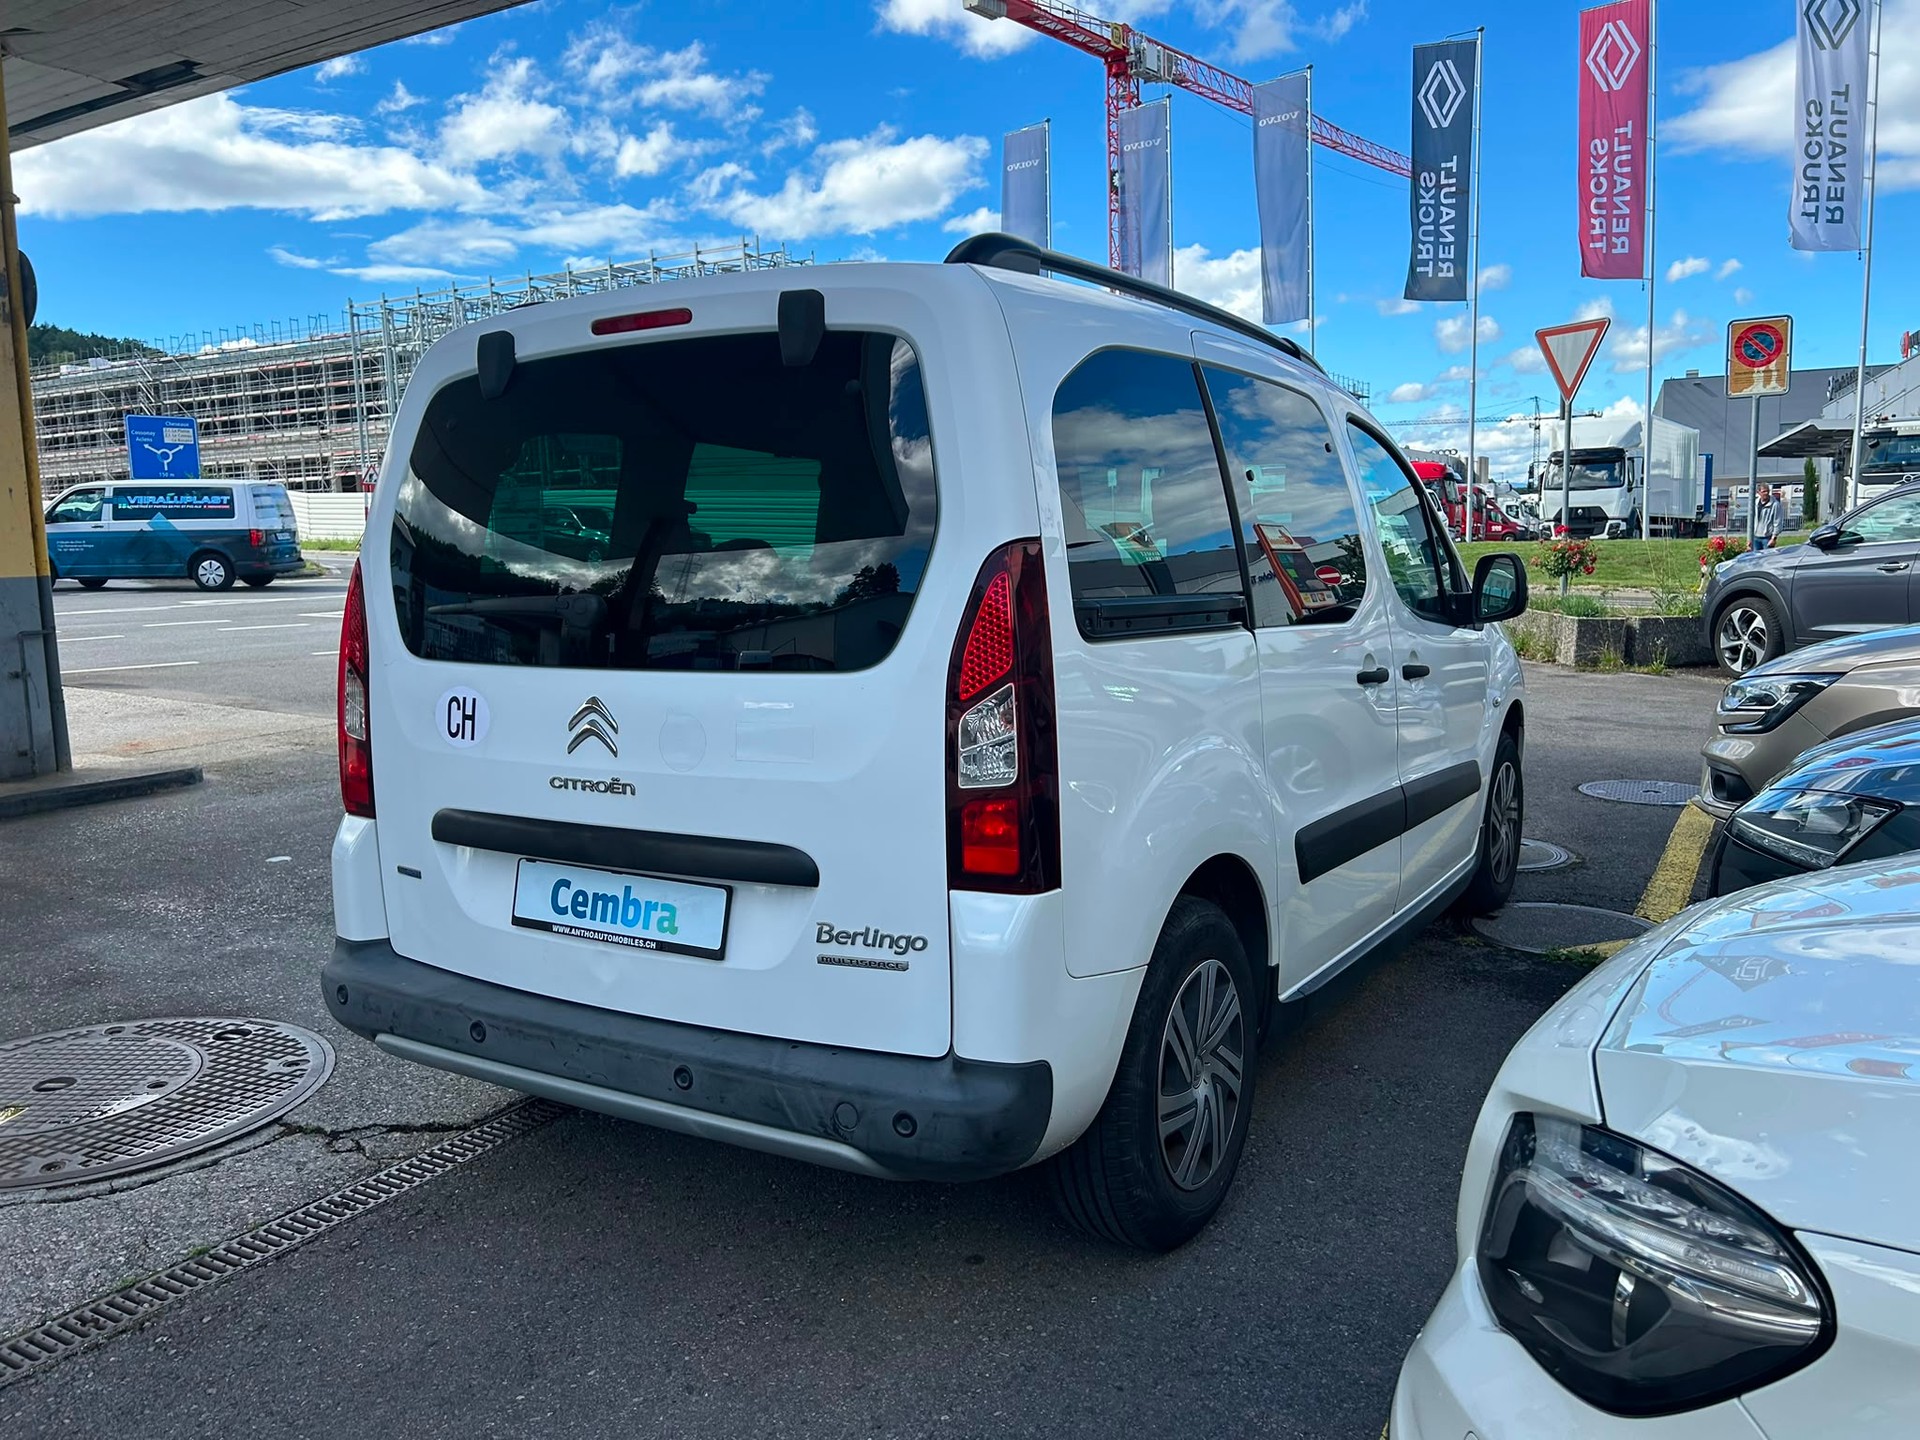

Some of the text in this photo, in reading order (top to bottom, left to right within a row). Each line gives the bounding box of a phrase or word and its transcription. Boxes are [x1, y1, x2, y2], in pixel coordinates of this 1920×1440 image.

[447, 695, 476, 741] CH
[550, 878, 678, 936] Cembra
[552, 924, 656, 950] WWW.ANTHOAUTOMOBILES.CH
[816, 921, 929, 955] Berlingo
[820, 955, 905, 969] MULTISPACE
